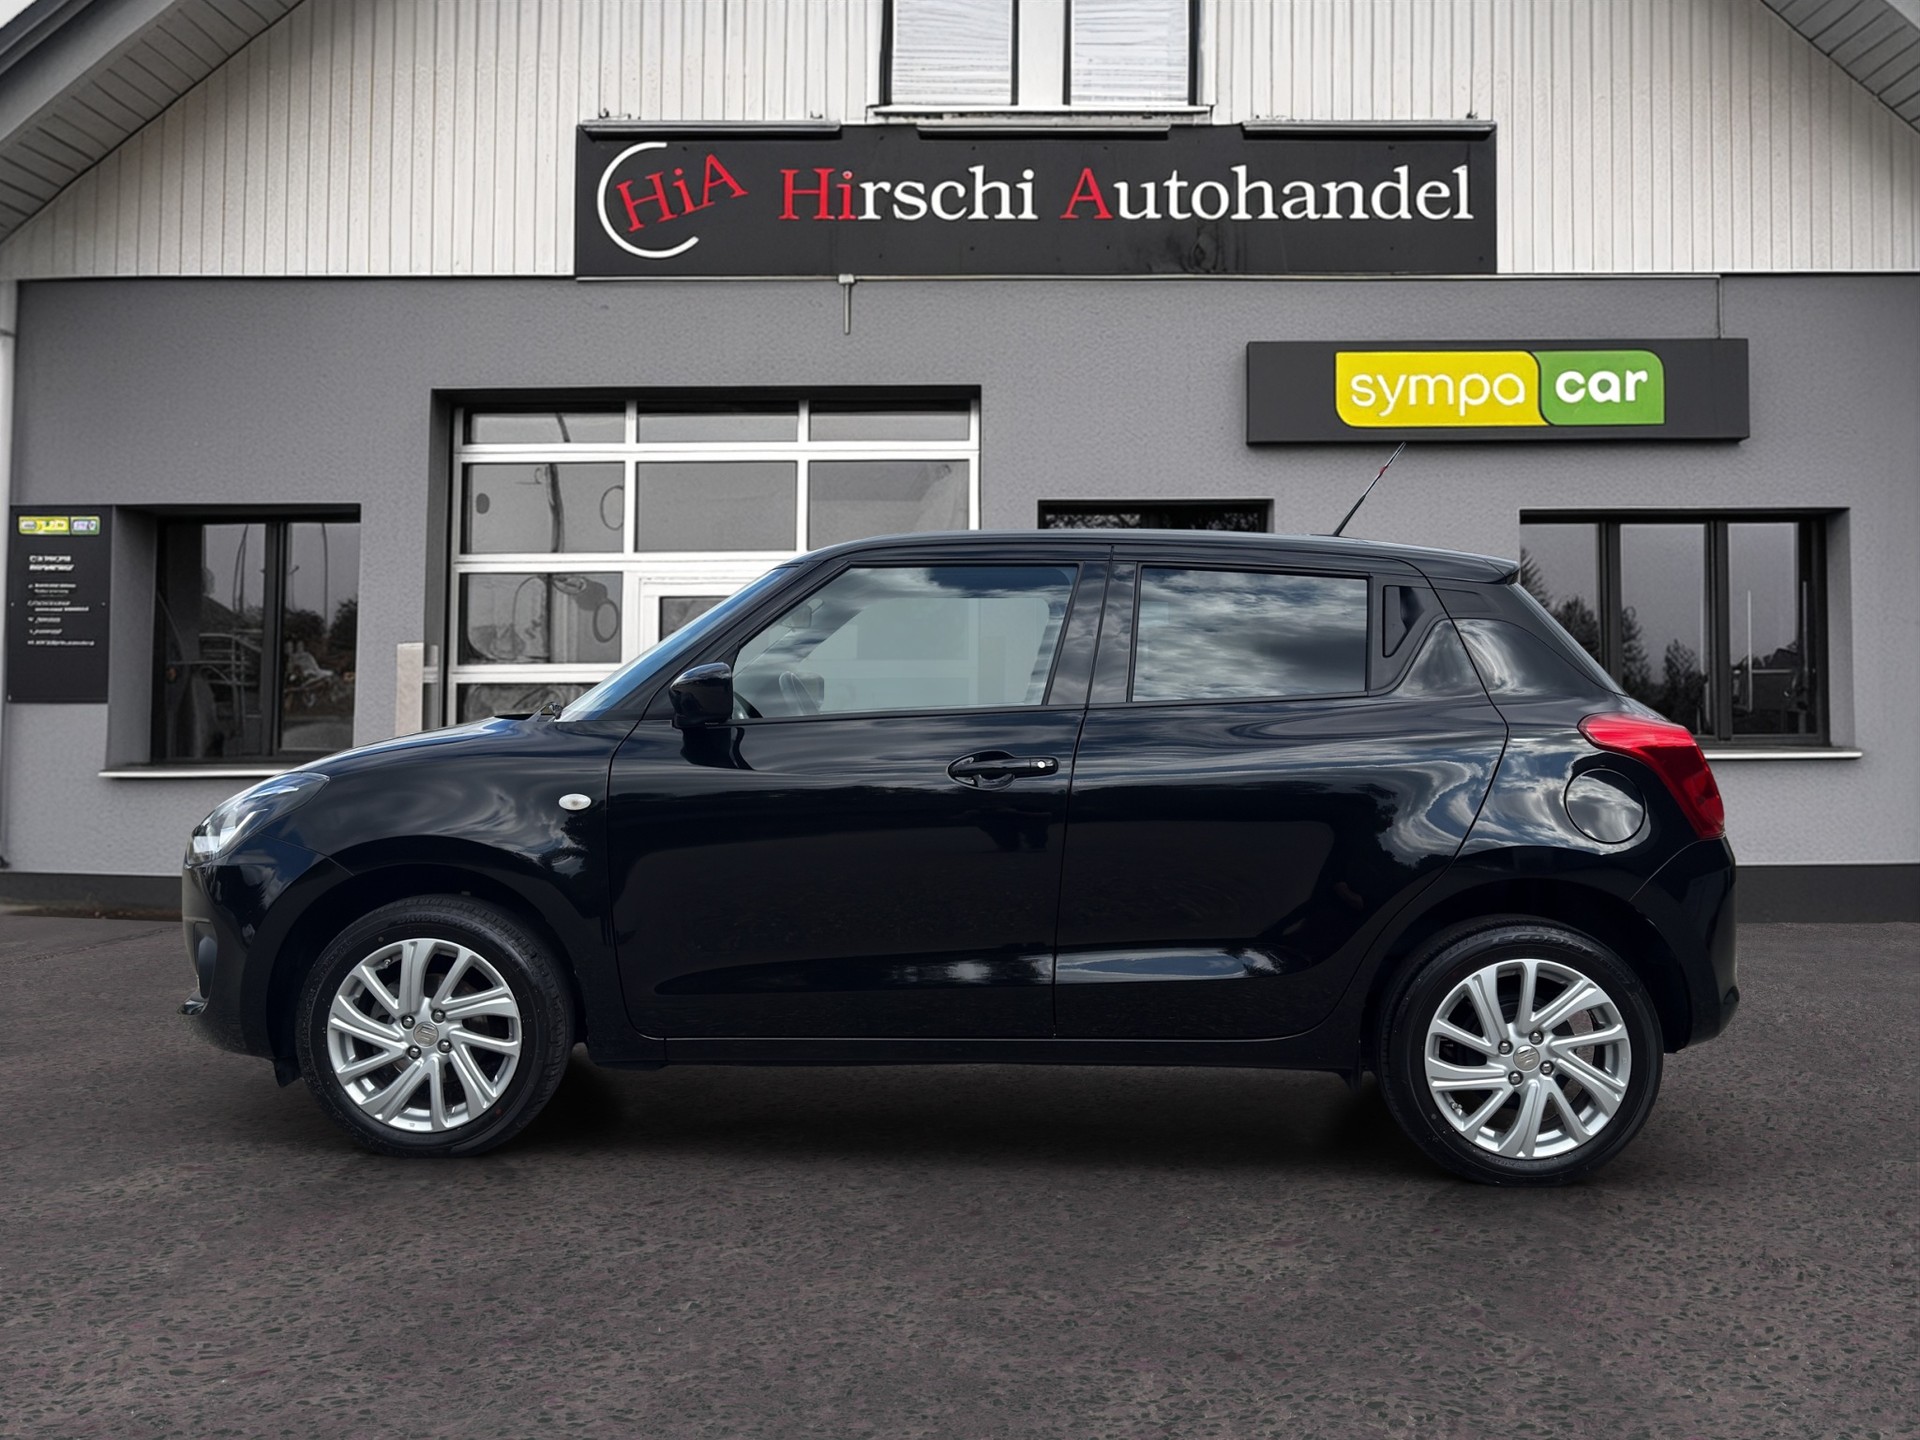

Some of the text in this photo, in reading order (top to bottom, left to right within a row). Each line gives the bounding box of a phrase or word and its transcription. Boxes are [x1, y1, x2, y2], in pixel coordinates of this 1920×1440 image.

[616, 153, 749, 232] HiA
[778, 164, 1474, 221] Hirschi Autohandel
[1350, 368, 1648, 416] sympa car
